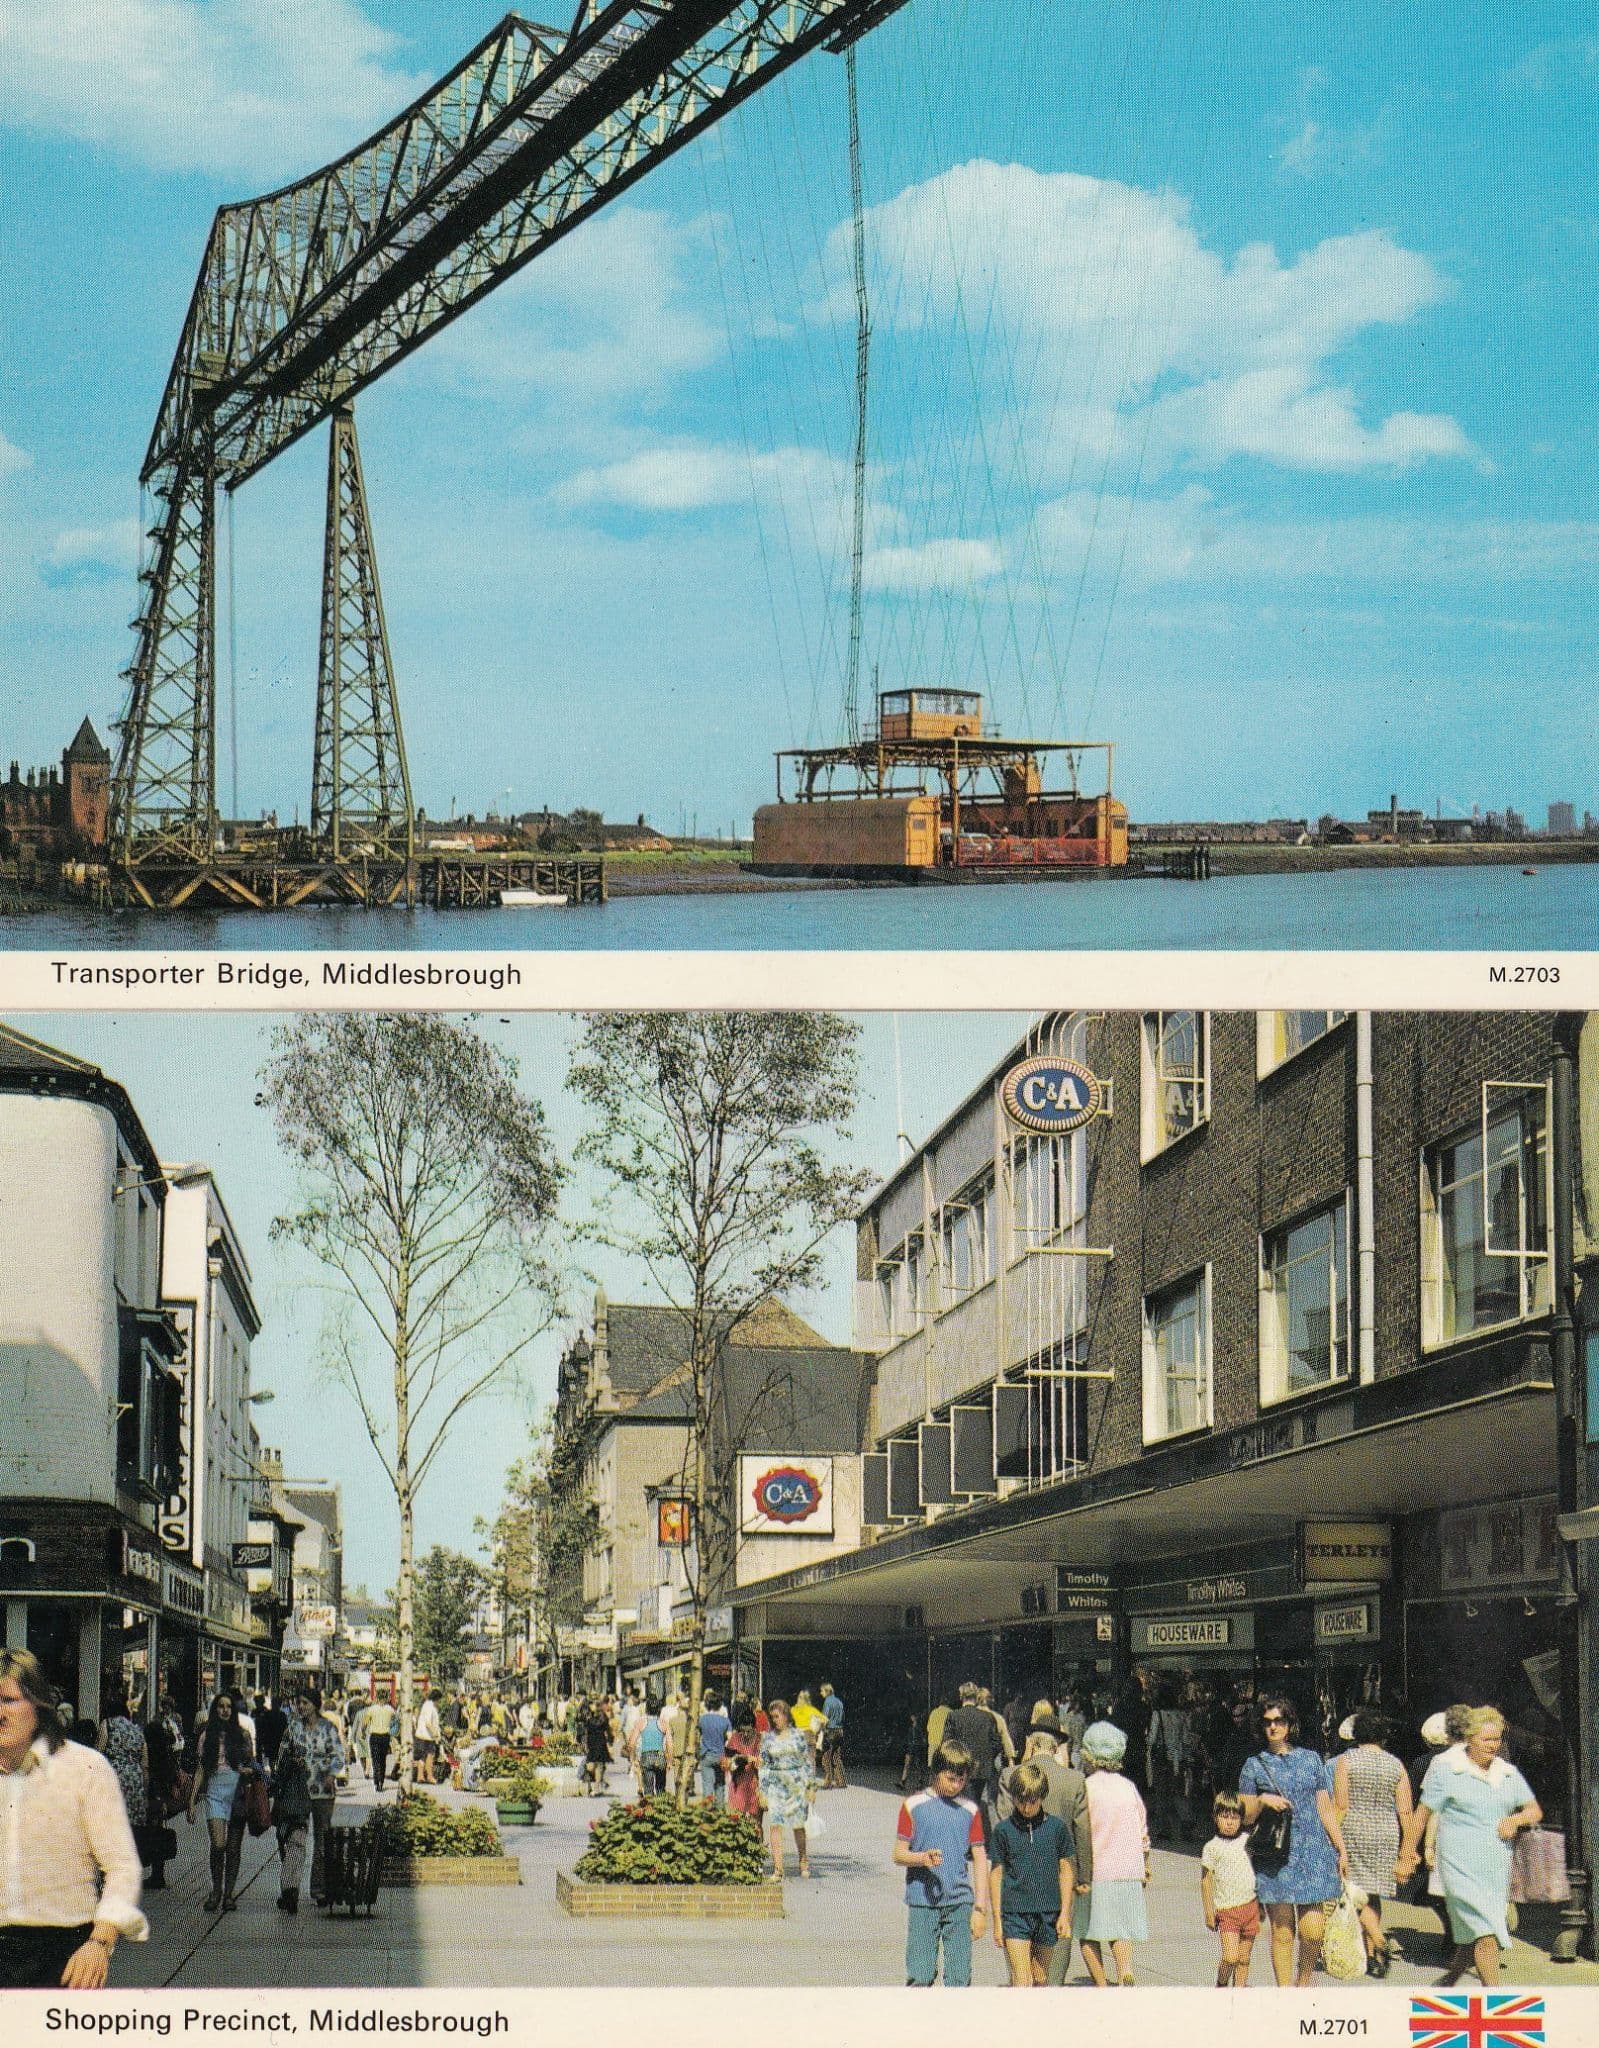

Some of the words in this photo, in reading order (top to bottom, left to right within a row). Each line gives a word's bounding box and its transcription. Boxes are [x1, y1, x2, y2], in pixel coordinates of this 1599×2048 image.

[1022, 1076, 1083, 1111] C&A
[765, 1483, 811, 1504] C&A
[1065, 1572, 1110, 1586] Timothy
[1068, 1595, 1109, 1608] Whites
[1152, 1622, 1222, 1642] HOUSEWARE
